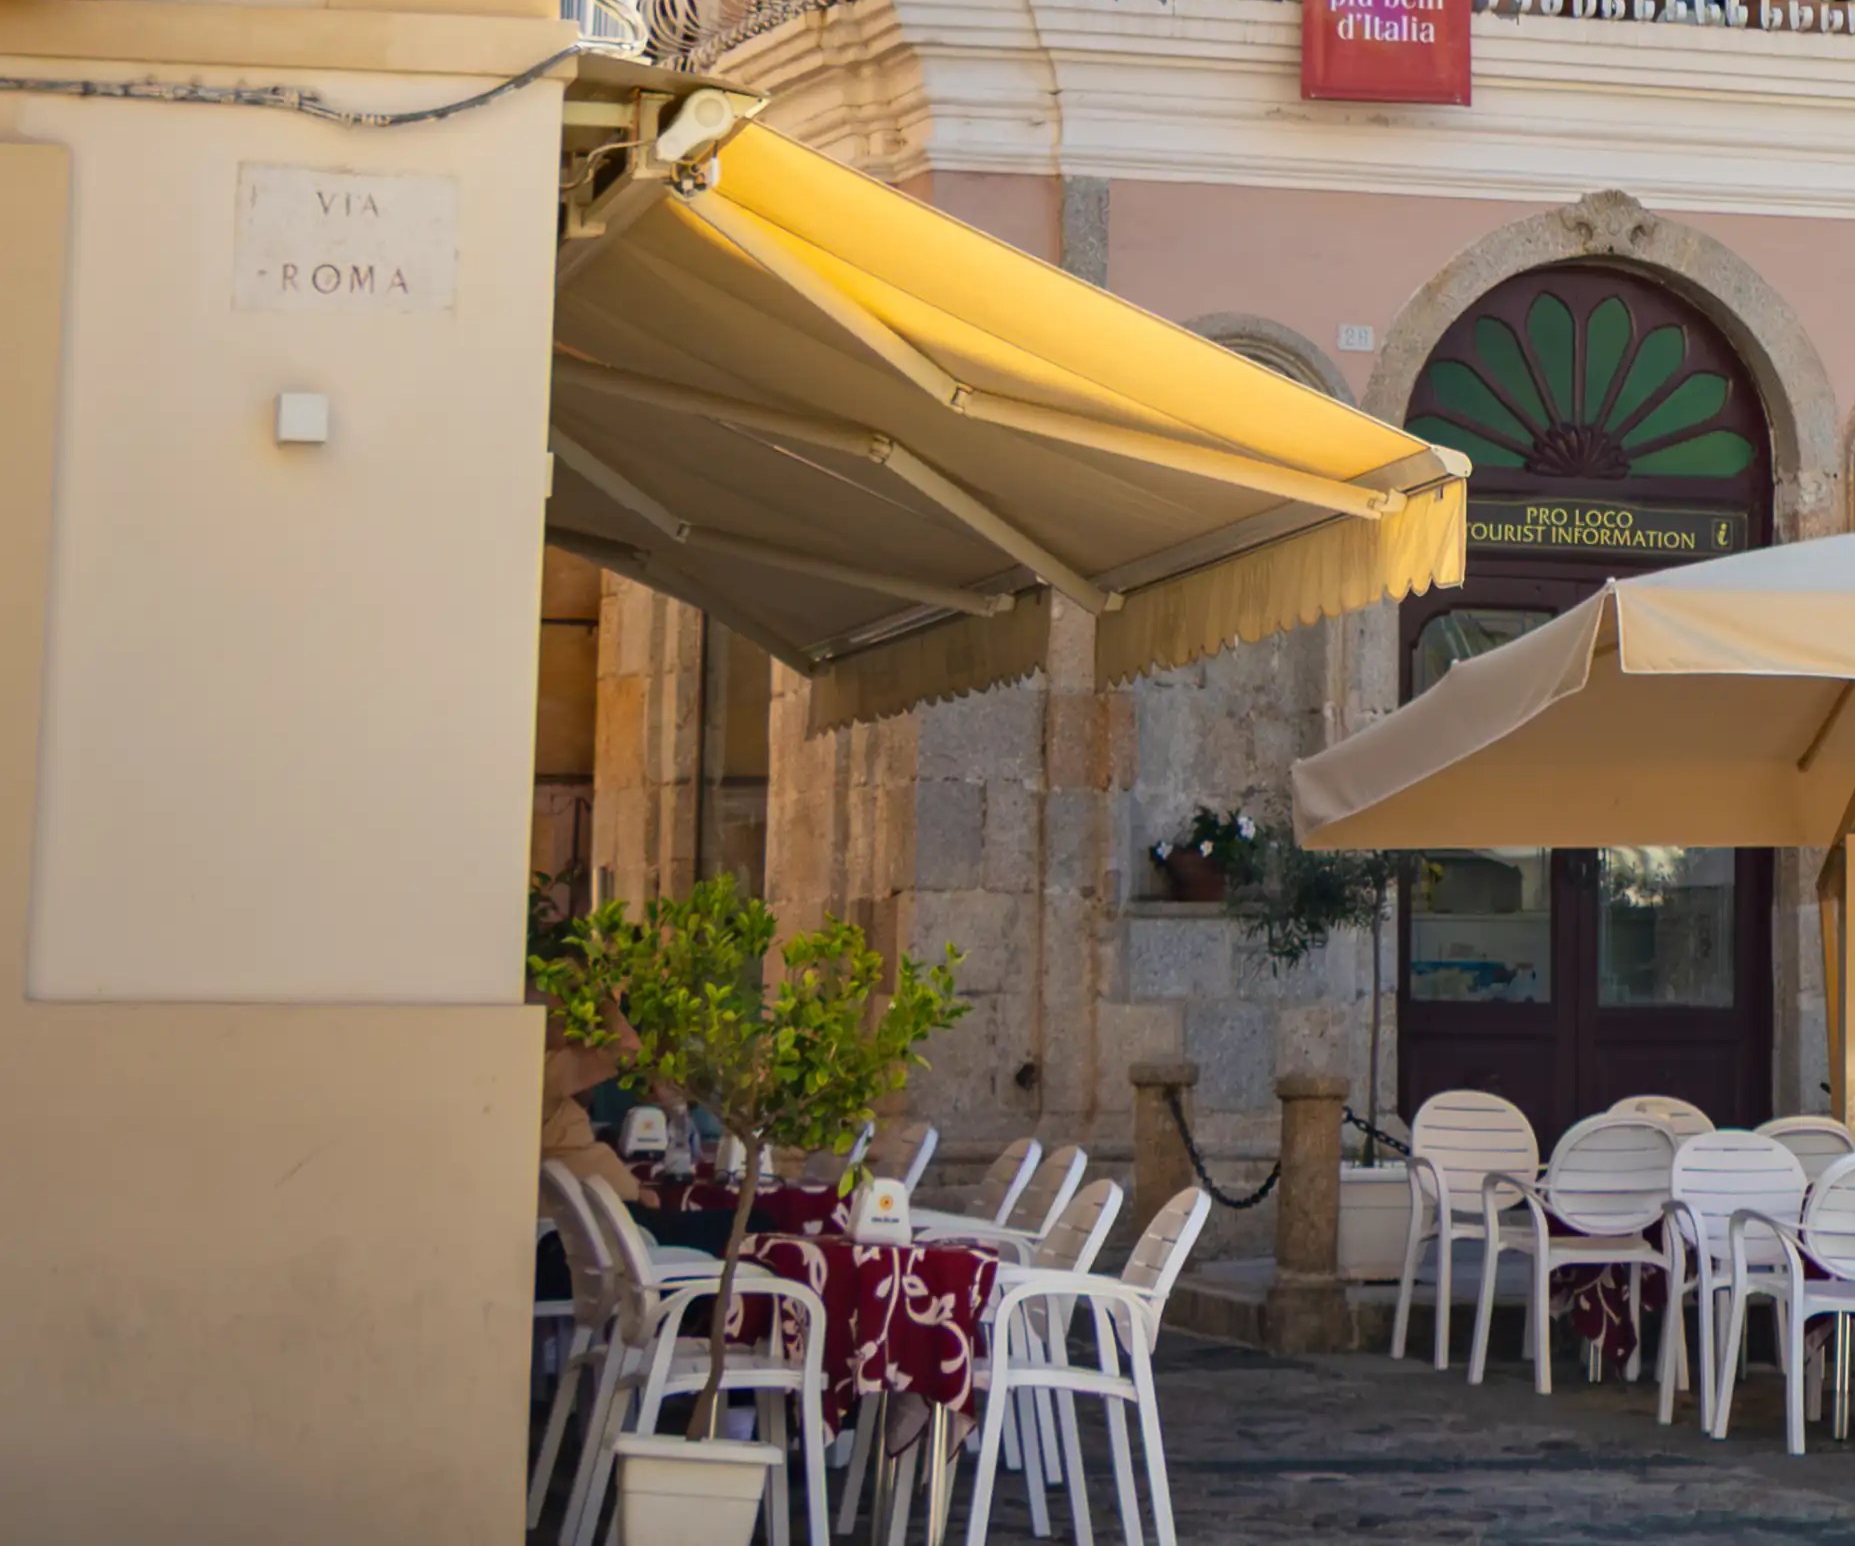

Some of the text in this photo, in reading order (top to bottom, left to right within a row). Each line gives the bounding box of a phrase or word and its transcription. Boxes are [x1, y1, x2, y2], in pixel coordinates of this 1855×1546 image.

[1337, 13, 1435, 43] d'Italia
[316, 191, 379, 217] VIA
[281, 263, 408, 294] ROMA
[1526, 507, 1634, 528] PRO LOCO
[1551, 525, 1696, 550] INFORMATION
